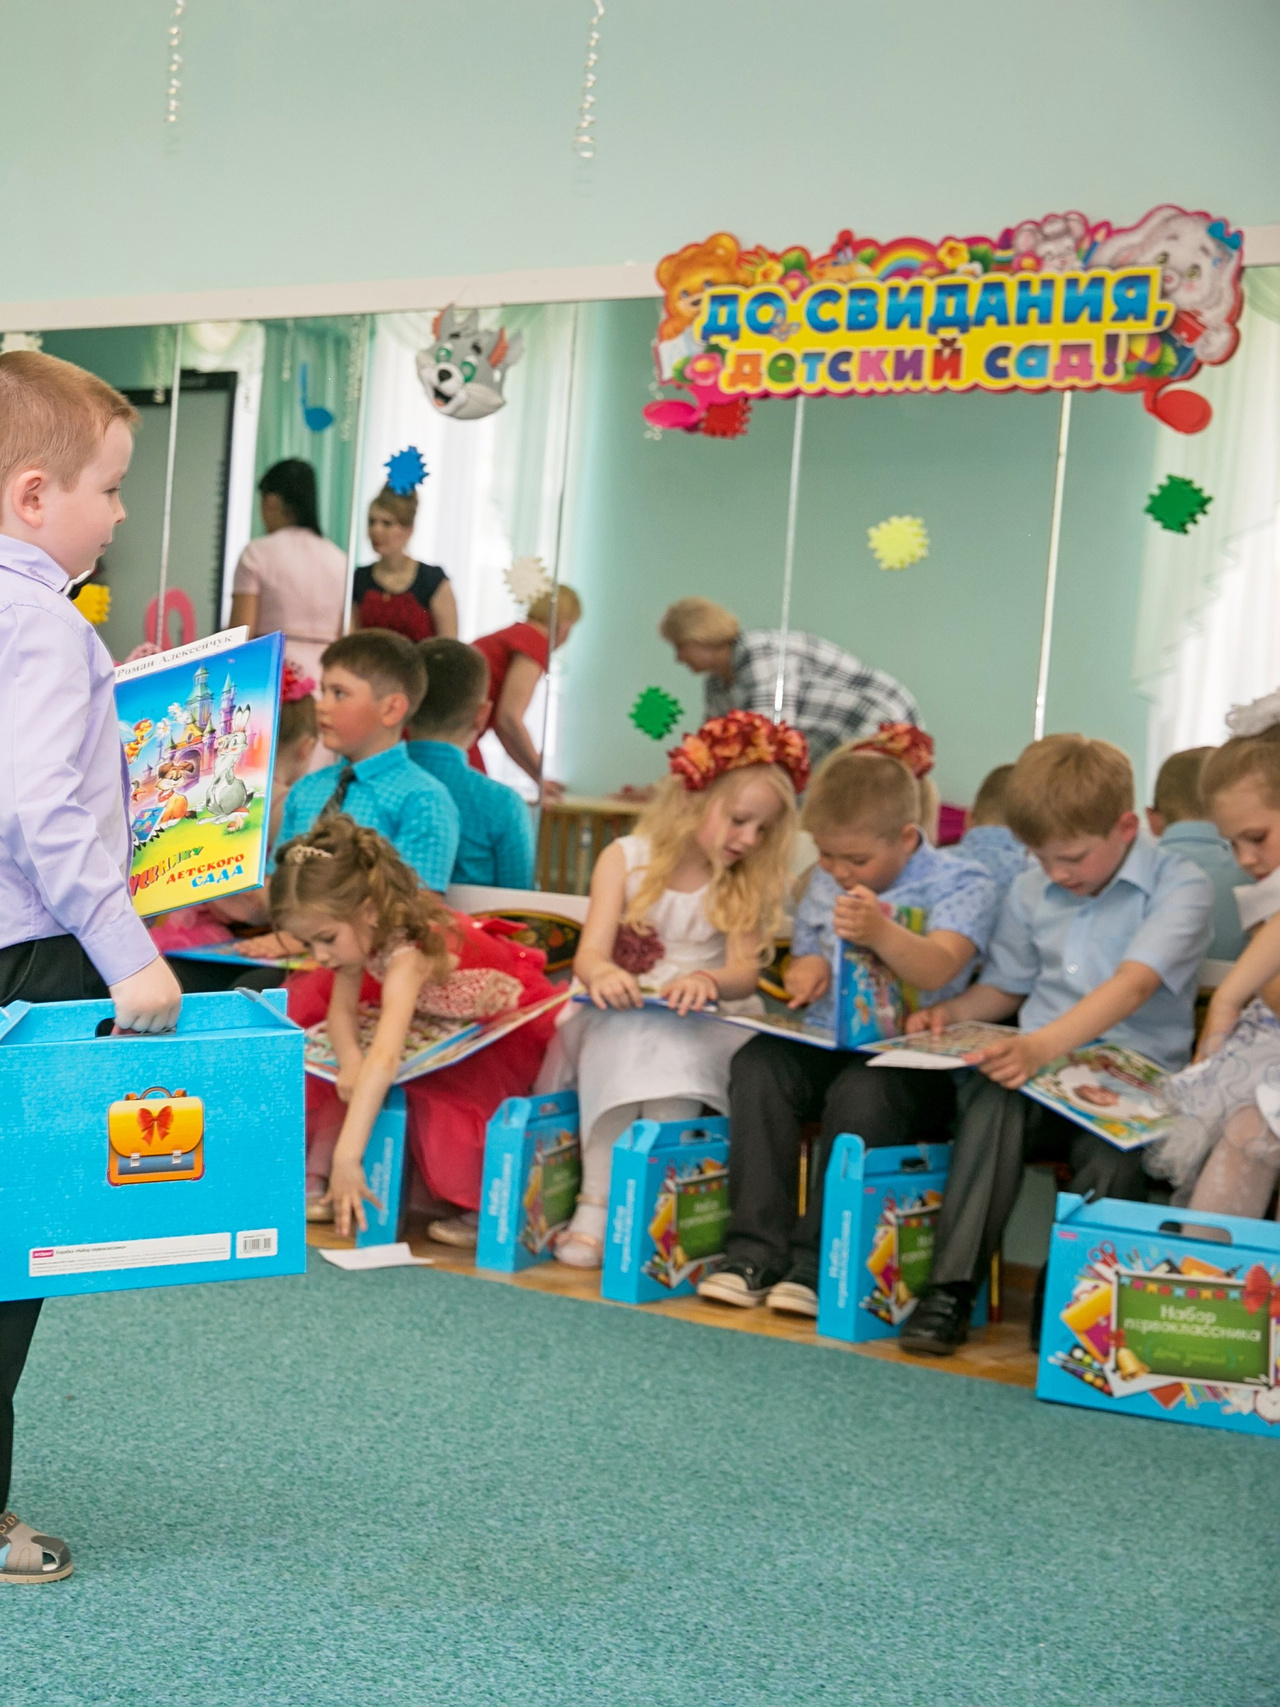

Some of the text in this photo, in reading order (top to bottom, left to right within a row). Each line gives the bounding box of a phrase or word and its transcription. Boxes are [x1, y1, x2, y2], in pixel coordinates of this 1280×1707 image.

[701, 273, 1172, 343] ДО СВИДАНИЯ,
[117, 660, 155, 678] Роман
[166, 853, 245, 885] ДЕТСКОГО
[191, 864, 244, 888] САДА
[1160, 1304, 1217, 1324] Набор
